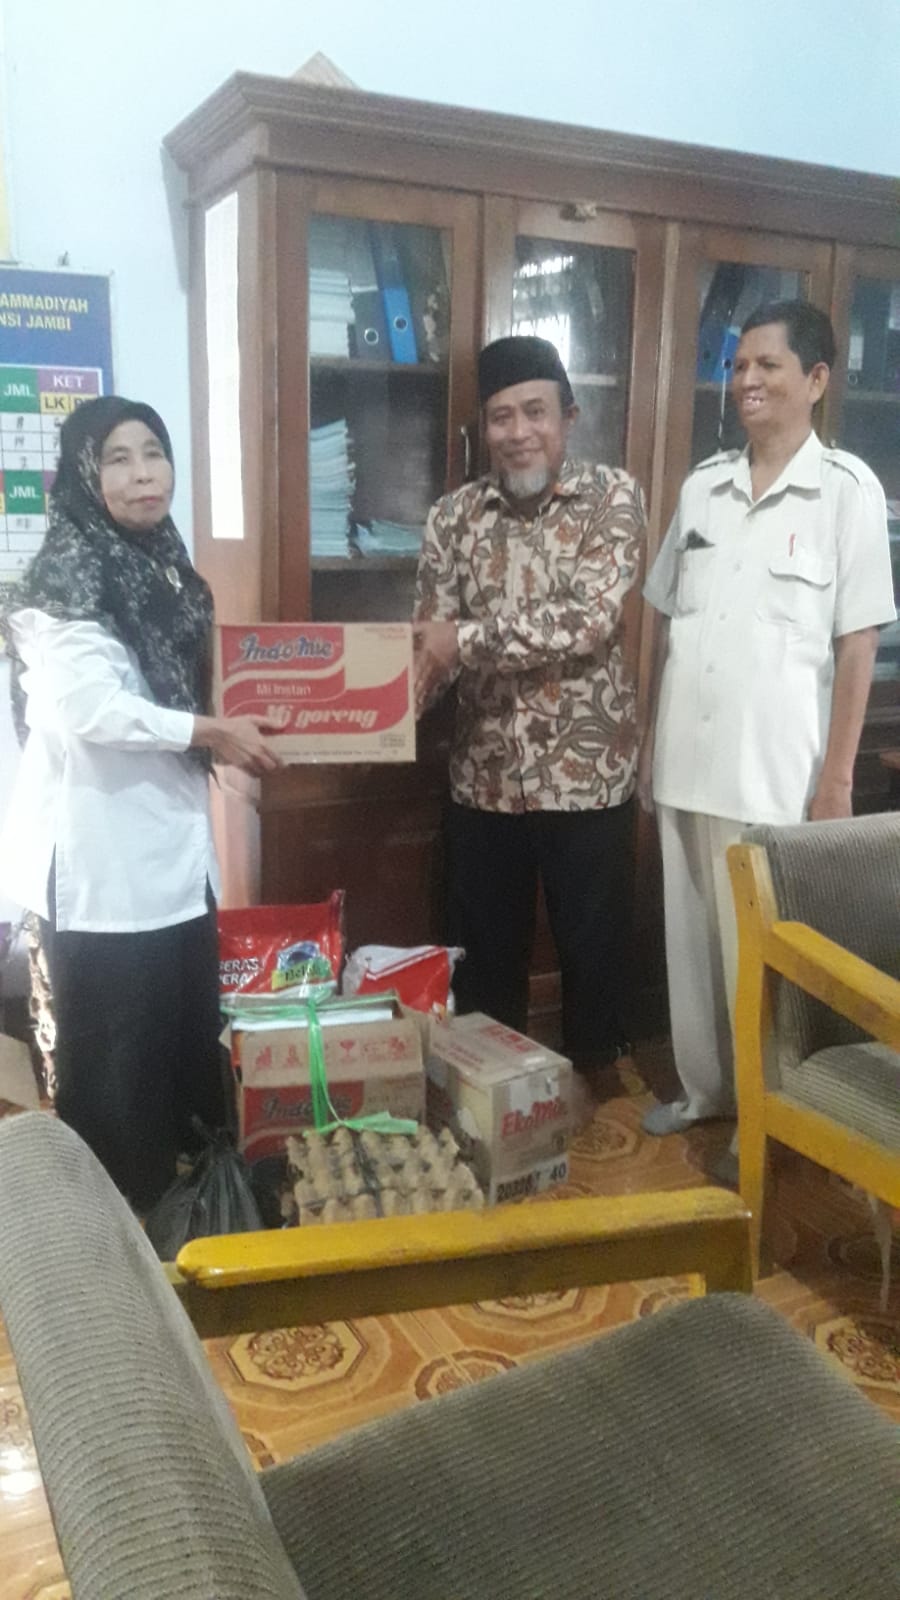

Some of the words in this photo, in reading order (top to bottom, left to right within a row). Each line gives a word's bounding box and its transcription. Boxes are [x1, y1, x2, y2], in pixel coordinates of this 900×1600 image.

[0, 293, 89, 313] AMMADIYAH
[26, 315, 71, 331] JAMBI
[53, 375, 85, 389] KET
[4, 383, 34, 397] JML
[44, 396, 66, 410] LK
[9, 485, 41, 499] JML
[294, 709, 378, 729] goreng
[550, 1163, 567, 1181] 40
